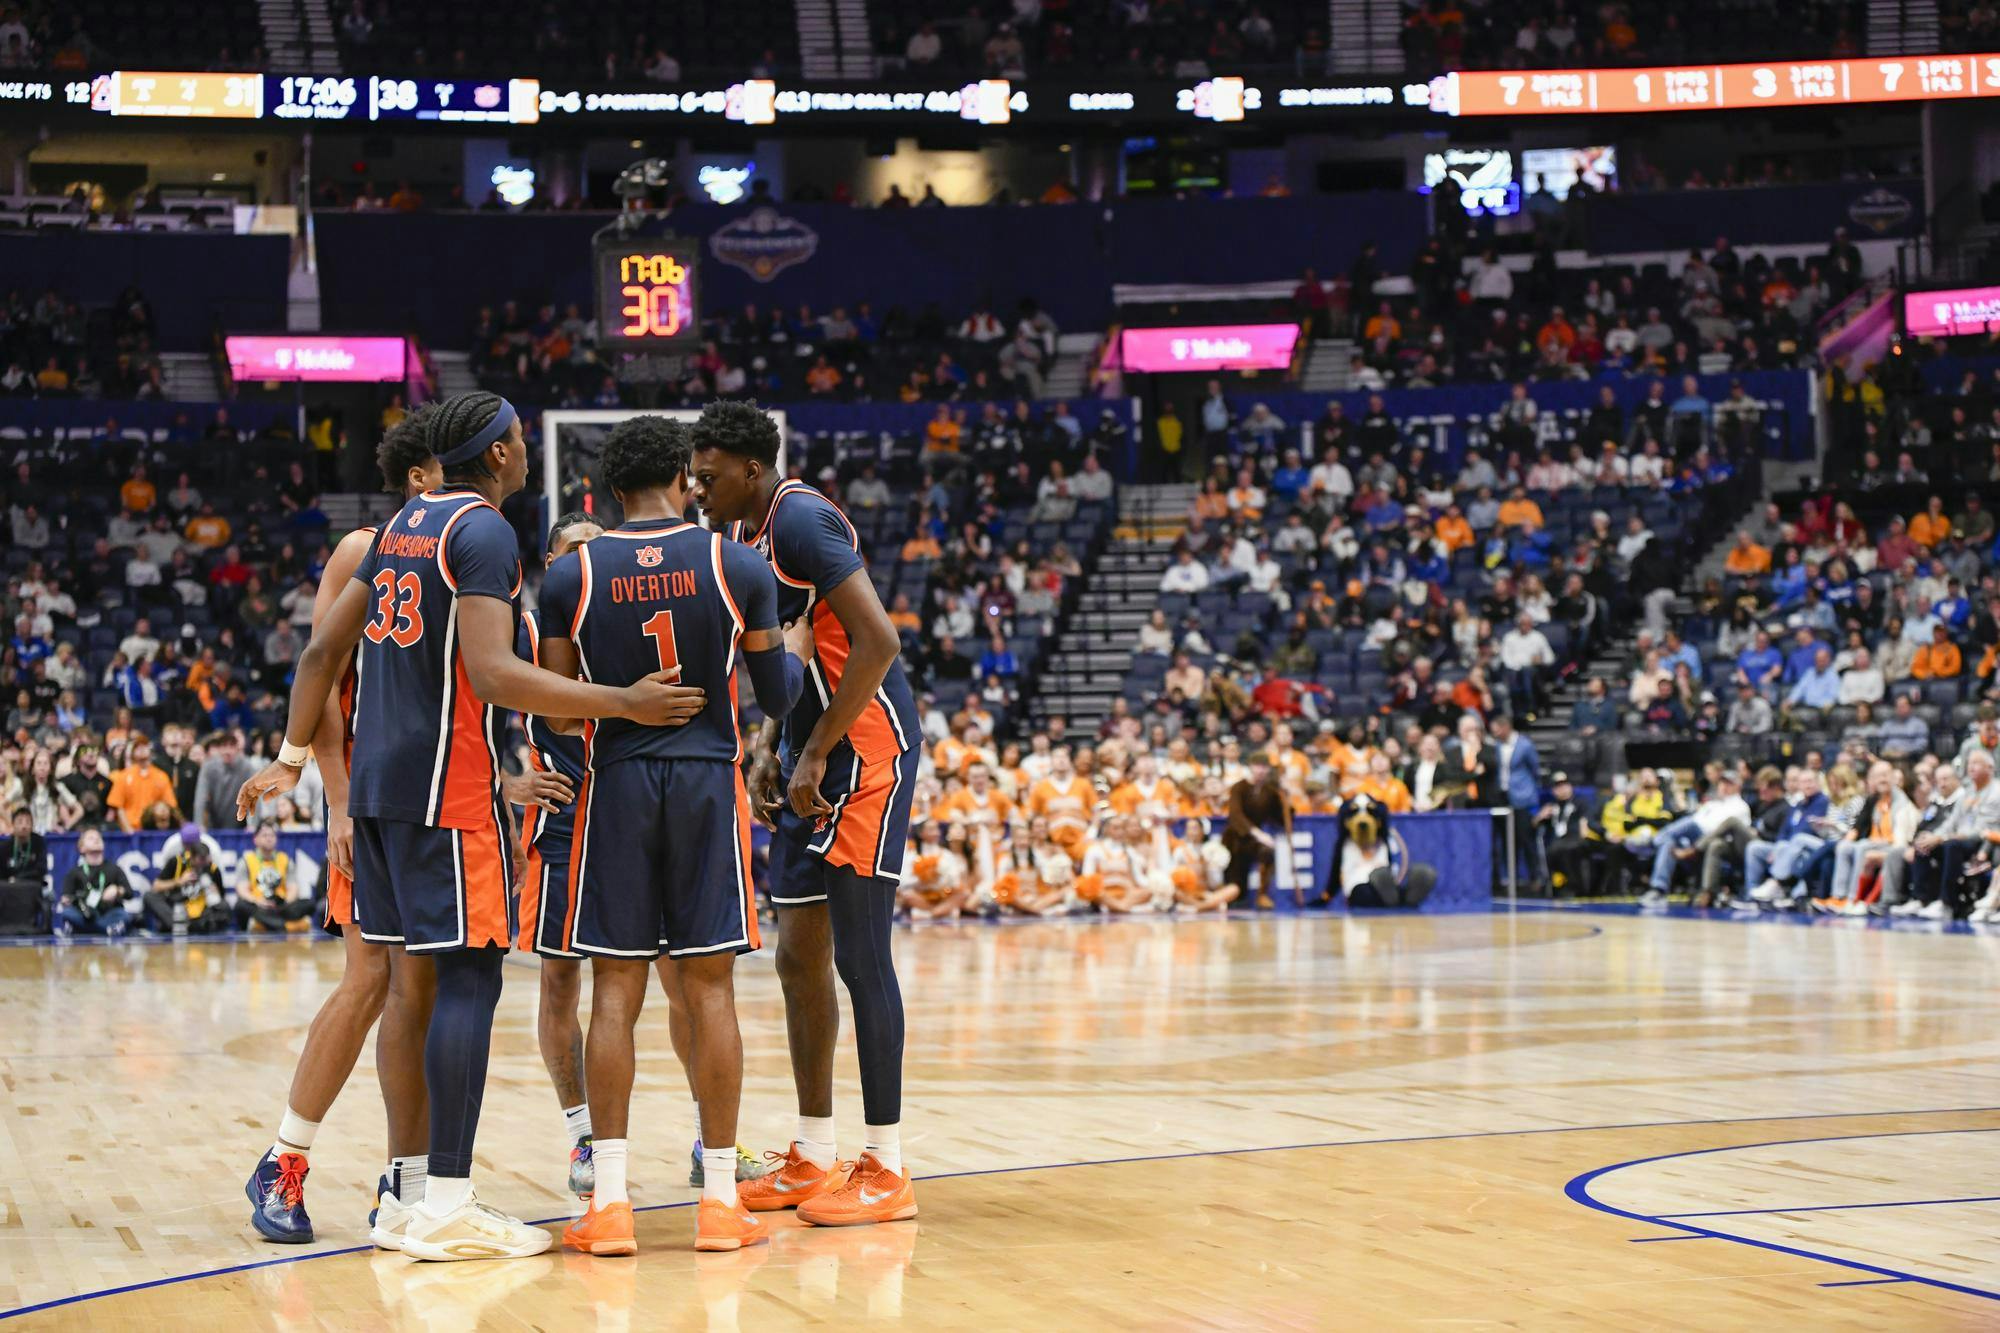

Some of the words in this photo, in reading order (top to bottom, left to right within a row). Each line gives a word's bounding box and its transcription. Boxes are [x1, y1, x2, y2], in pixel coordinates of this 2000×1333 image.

[25, 83, 51, 99] PTS
[64, 82, 90, 102] 12
[223, 77, 256, 107] 31
[280, 77, 357, 105] 17:06
[1499, 76, 1525, 105] 7
[1633, 73, 1651, 103] 1
[1752, 67, 1777, 98] 3
[1879, 63, 1904, 92] 7
[378, 79, 418, 110] 38
[621, 254, 685, 284] 17:06
[622, 285, 680, 336] 30
[611, 570, 696, 603] OVERTON
[364, 568, 424, 648] 33
[642, 610, 681, 685] 1
